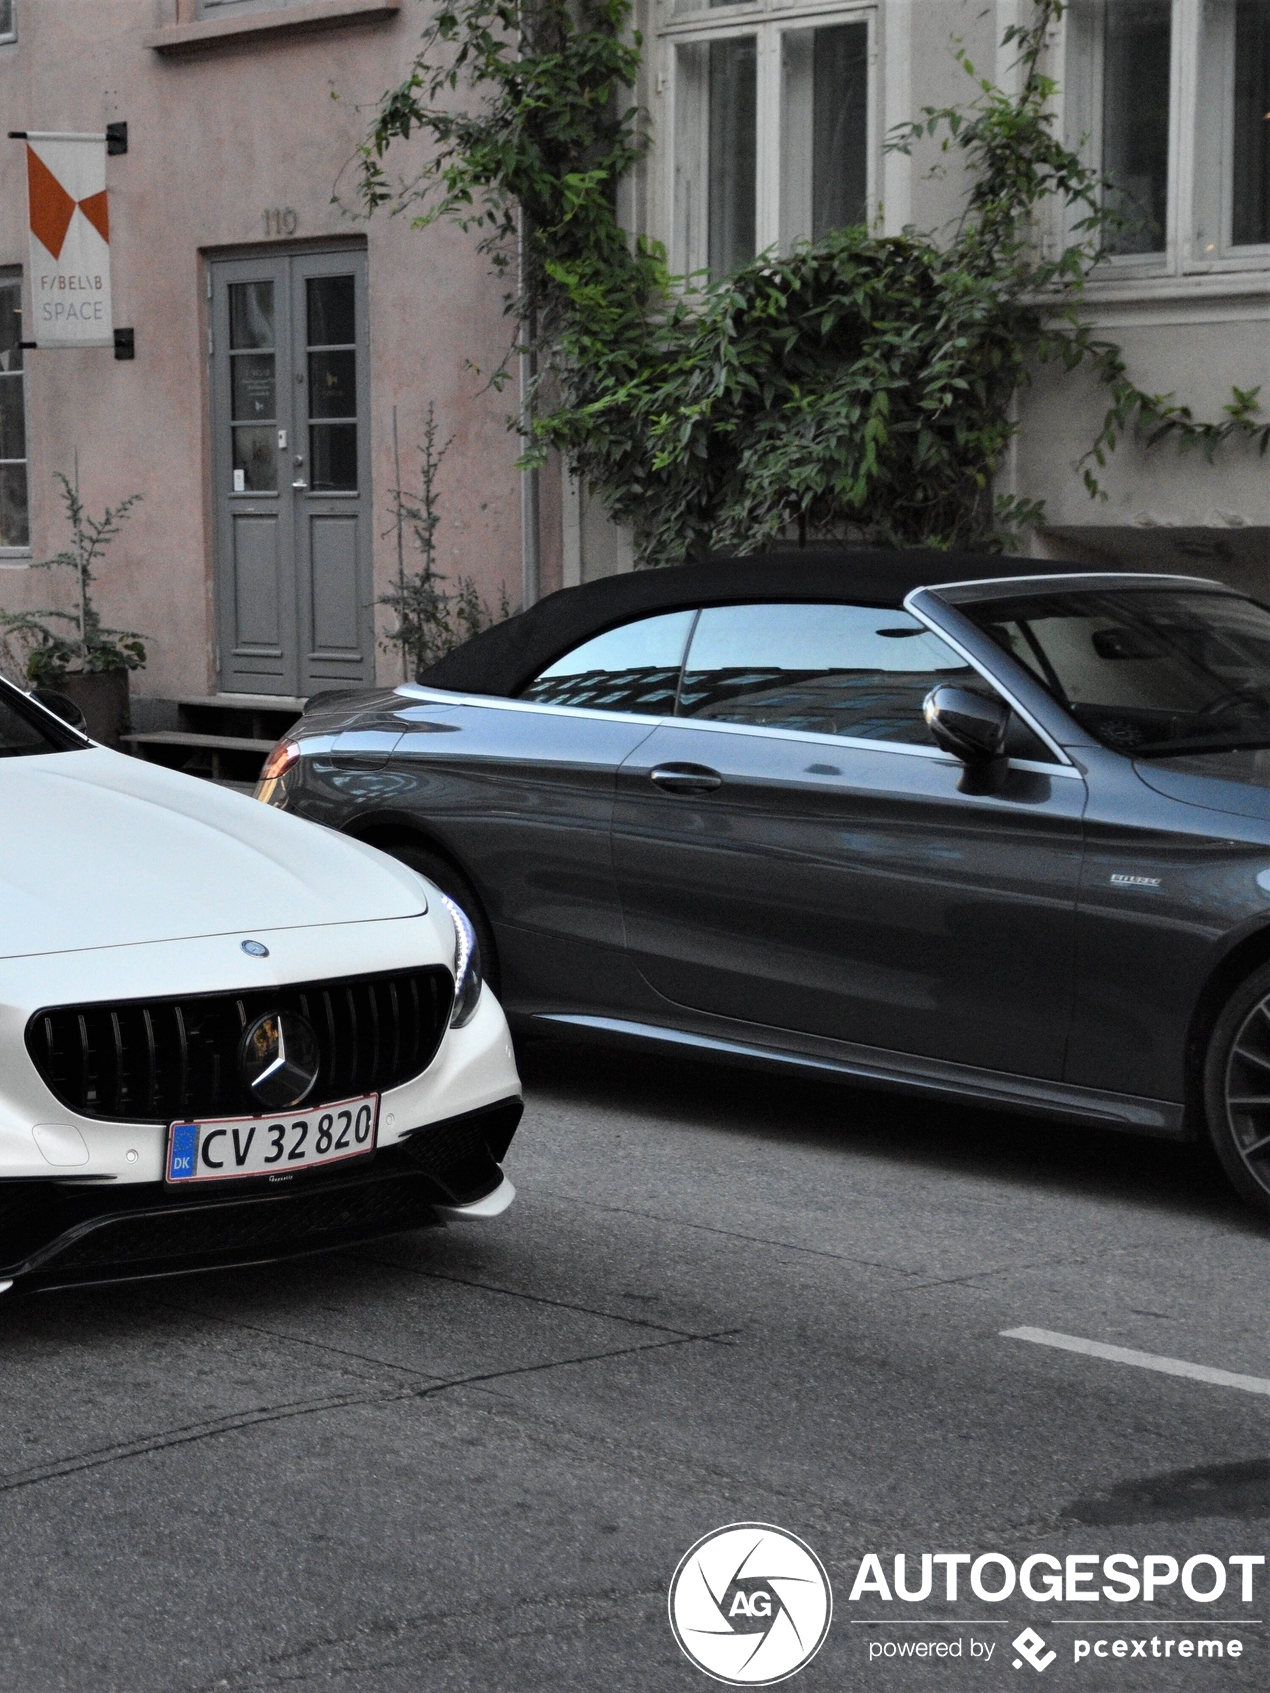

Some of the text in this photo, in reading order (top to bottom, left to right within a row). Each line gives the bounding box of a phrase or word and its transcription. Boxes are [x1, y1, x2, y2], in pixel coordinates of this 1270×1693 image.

[42, 302, 103, 321] SPACE
[201, 1104, 371, 1169] CV 32 820
[174, 1157, 190, 1169] DK
